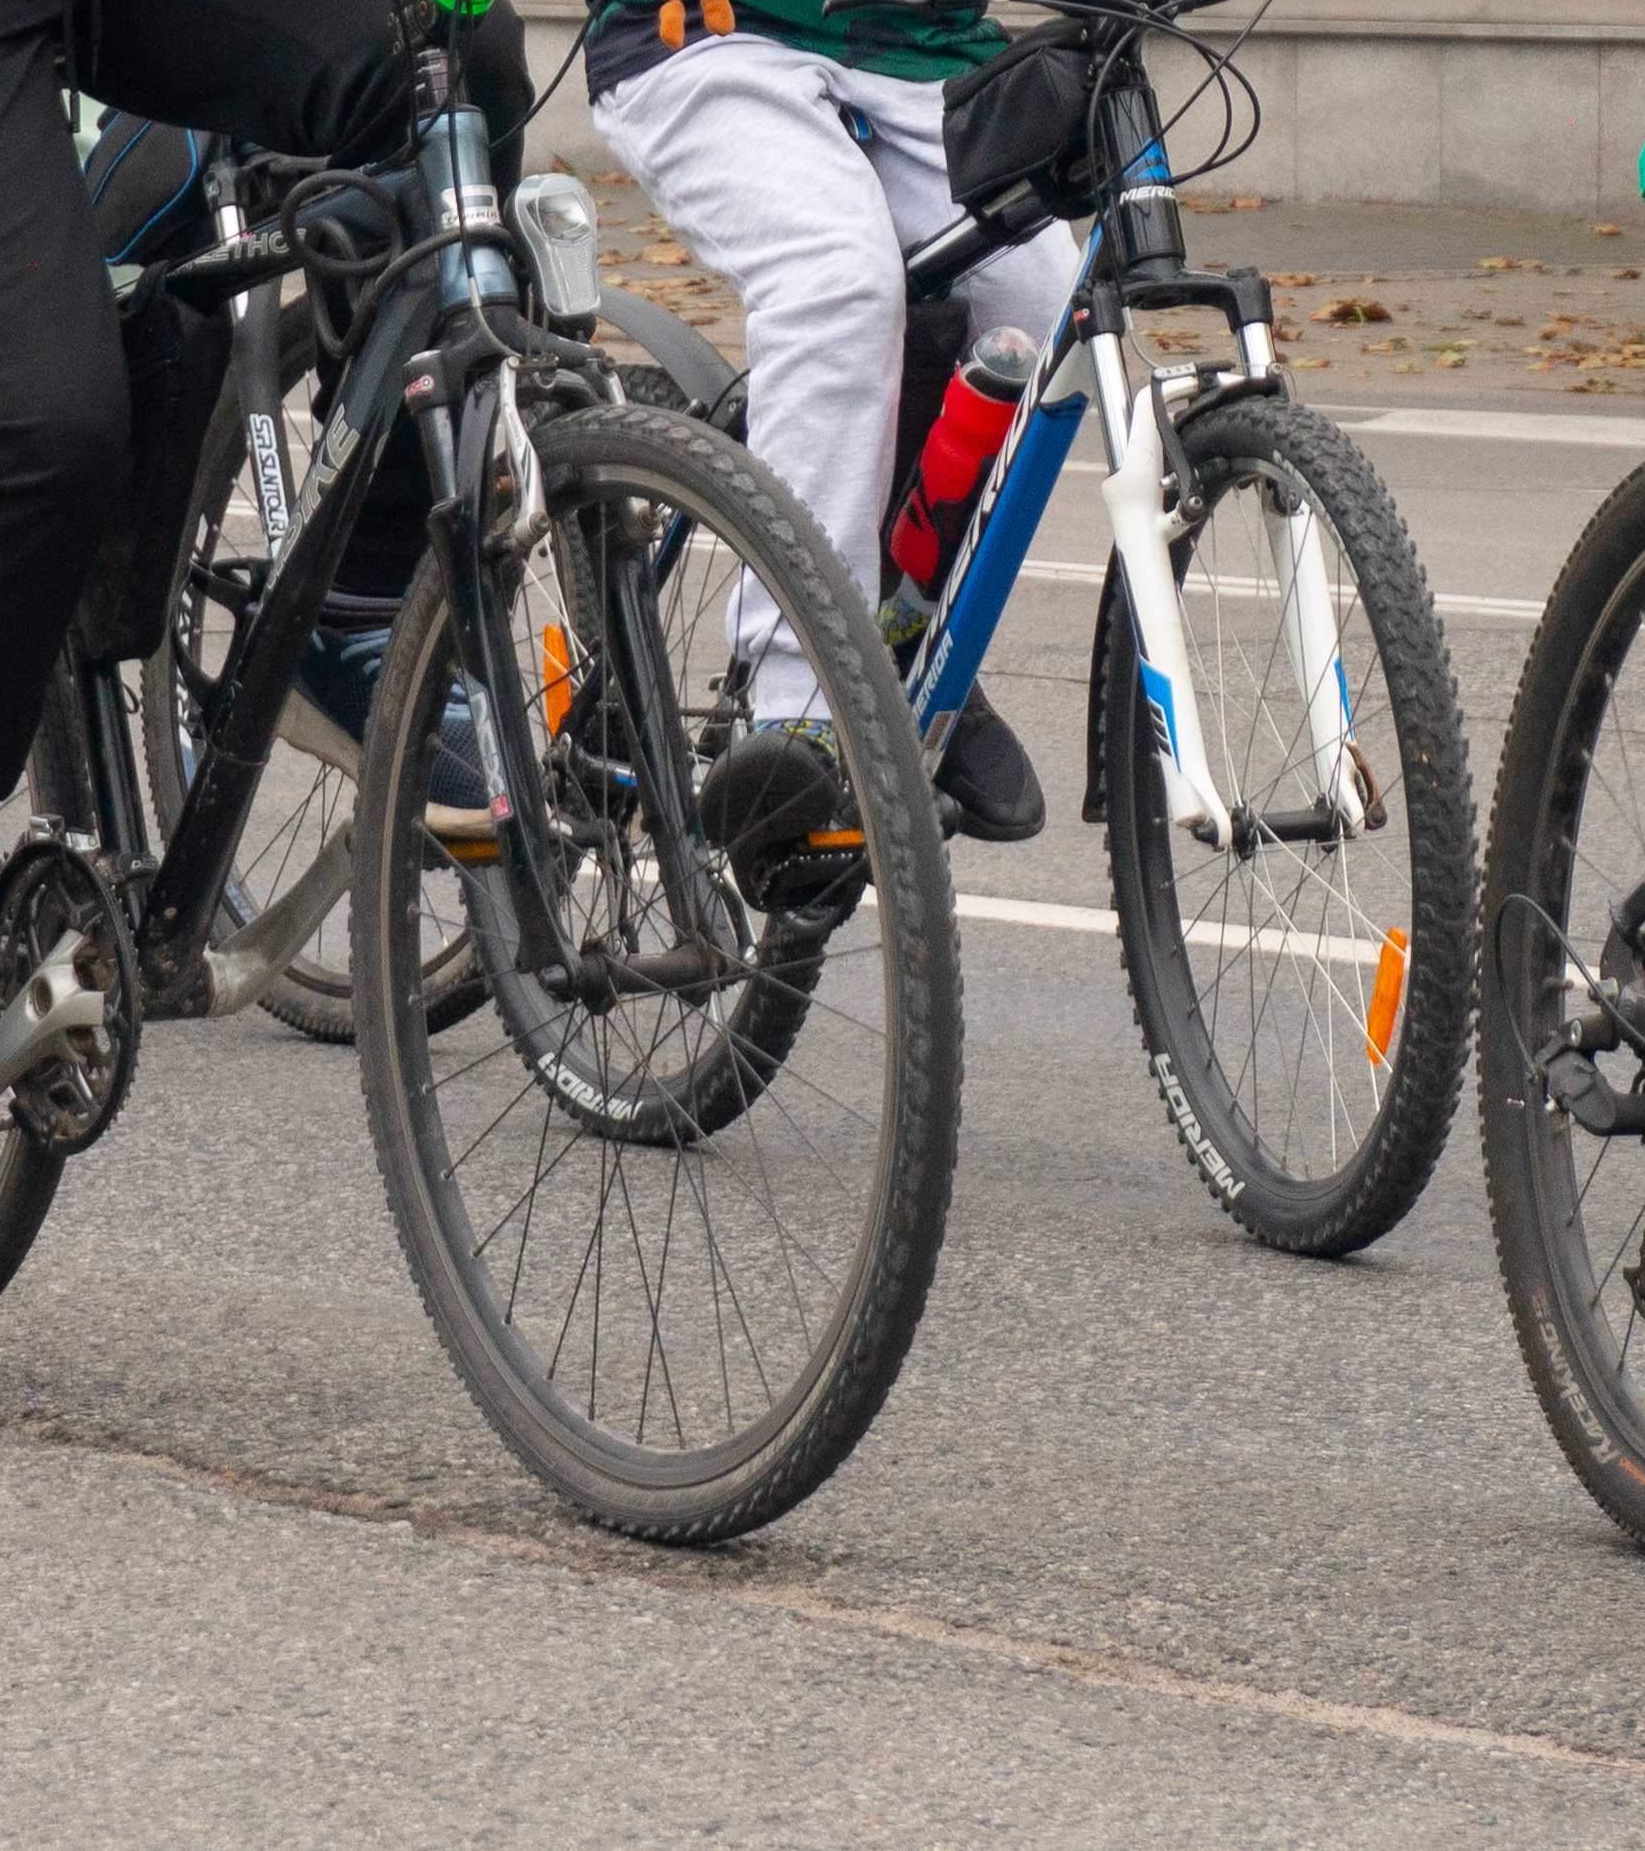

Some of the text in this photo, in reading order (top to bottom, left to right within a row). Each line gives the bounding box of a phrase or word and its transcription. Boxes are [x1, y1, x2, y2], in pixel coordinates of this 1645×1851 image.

[258, 451, 289, 538] SUNTOUR
[537, 1052, 644, 1122] MERIDA
[1154, 1052, 1247, 1200] MERIDA
